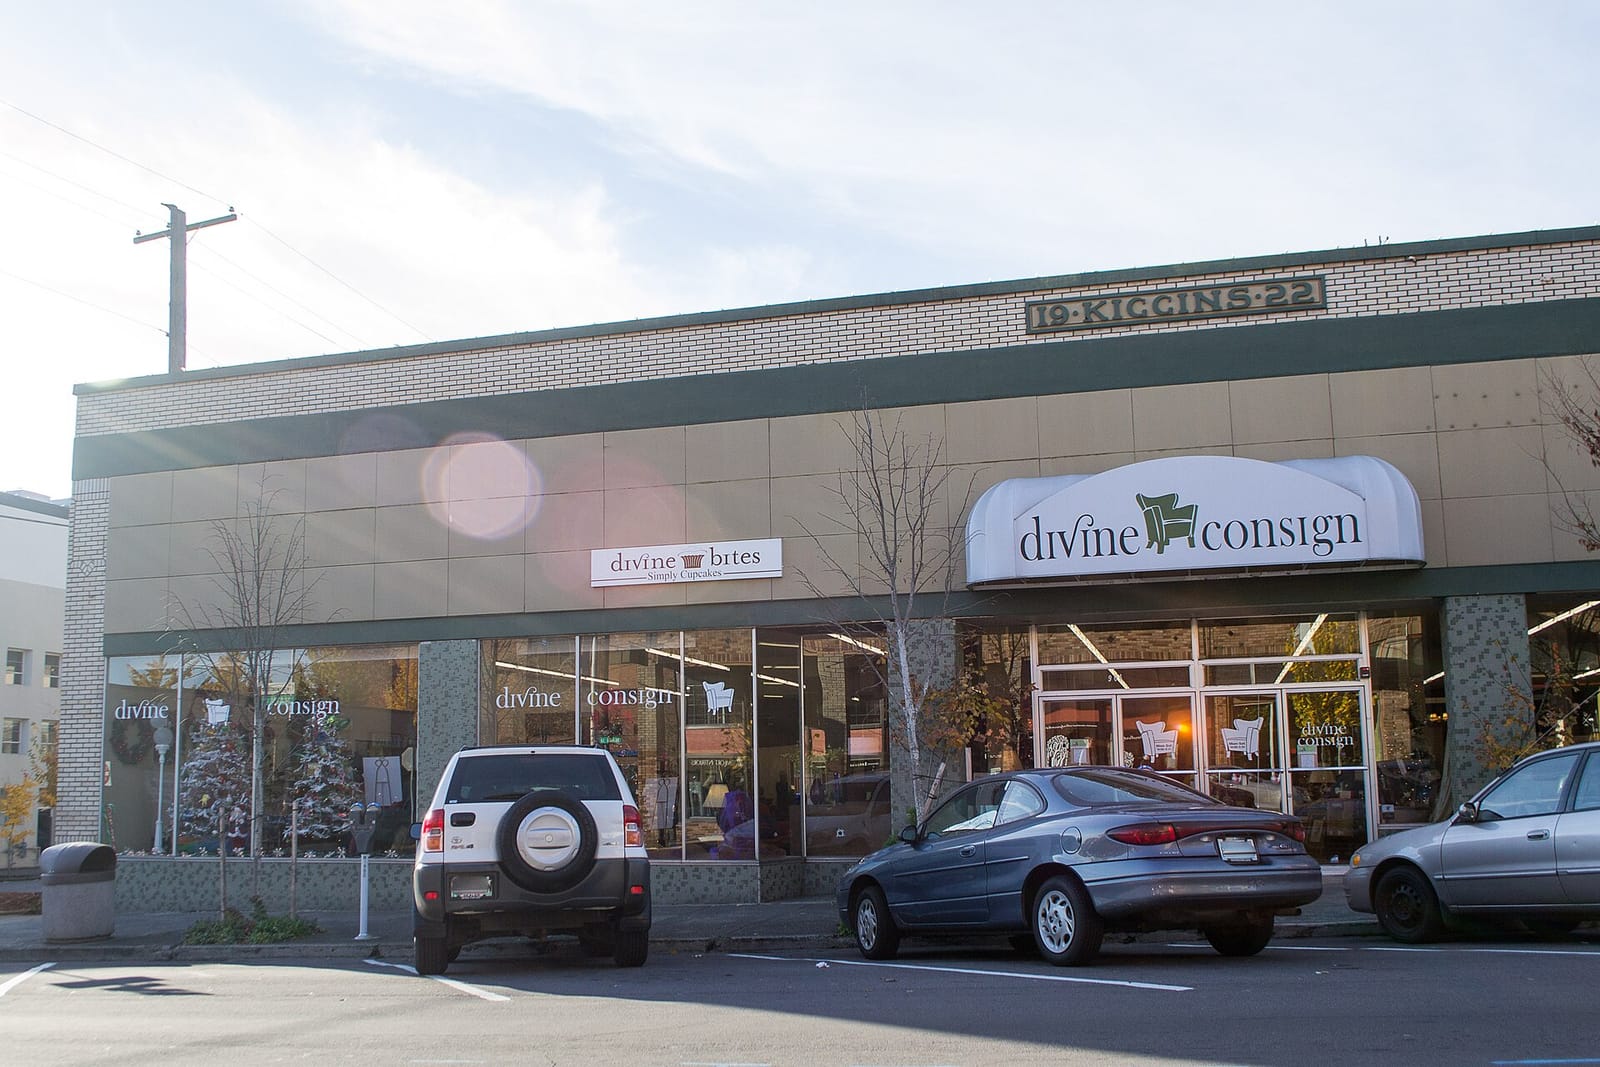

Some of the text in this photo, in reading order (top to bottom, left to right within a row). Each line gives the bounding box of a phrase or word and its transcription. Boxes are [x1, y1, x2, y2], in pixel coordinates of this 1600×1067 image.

[1020, 512, 1363, 562] divine consign
[611, 547, 761, 572] divine bites
[647, 568, 723, 582] Simply Cupcakes
[495, 686, 673, 709] divine consign
[114, 699, 169, 720] divine
[267, 699, 340, 718] consign
[1301, 721, 1347, 736] divine
[1297, 735, 1355, 749] consign
